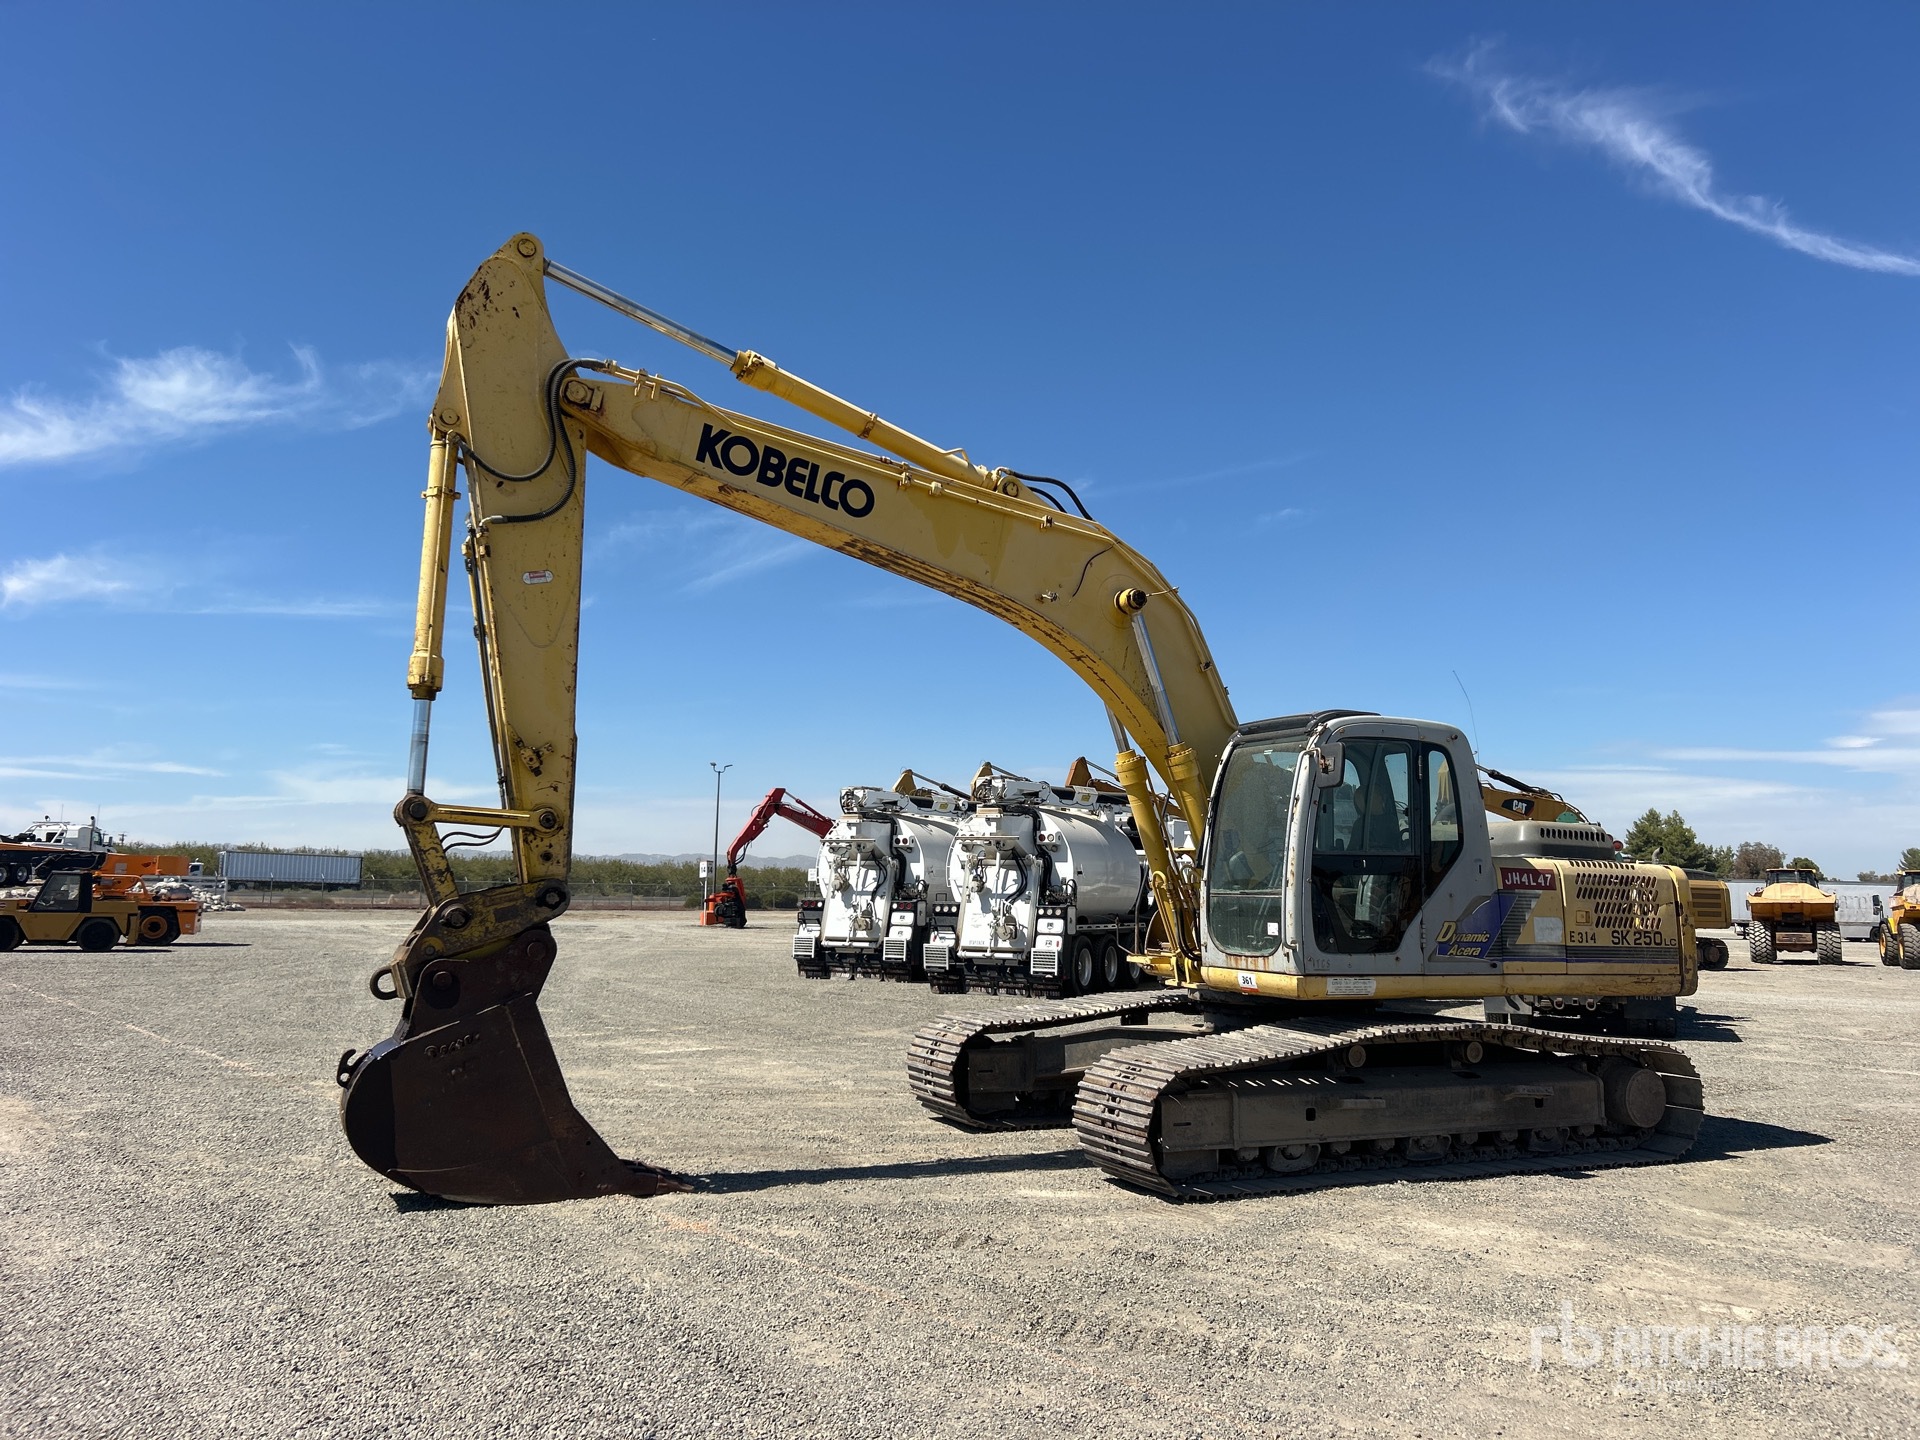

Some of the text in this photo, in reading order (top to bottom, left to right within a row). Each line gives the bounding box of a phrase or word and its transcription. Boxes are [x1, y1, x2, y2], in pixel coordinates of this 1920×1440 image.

[695, 422, 875, 518] KOBELCO
[1512, 800, 1527, 814] CAT
[1436, 921, 1490, 945] Dynamic
[1447, 944, 1482, 956] Acera
